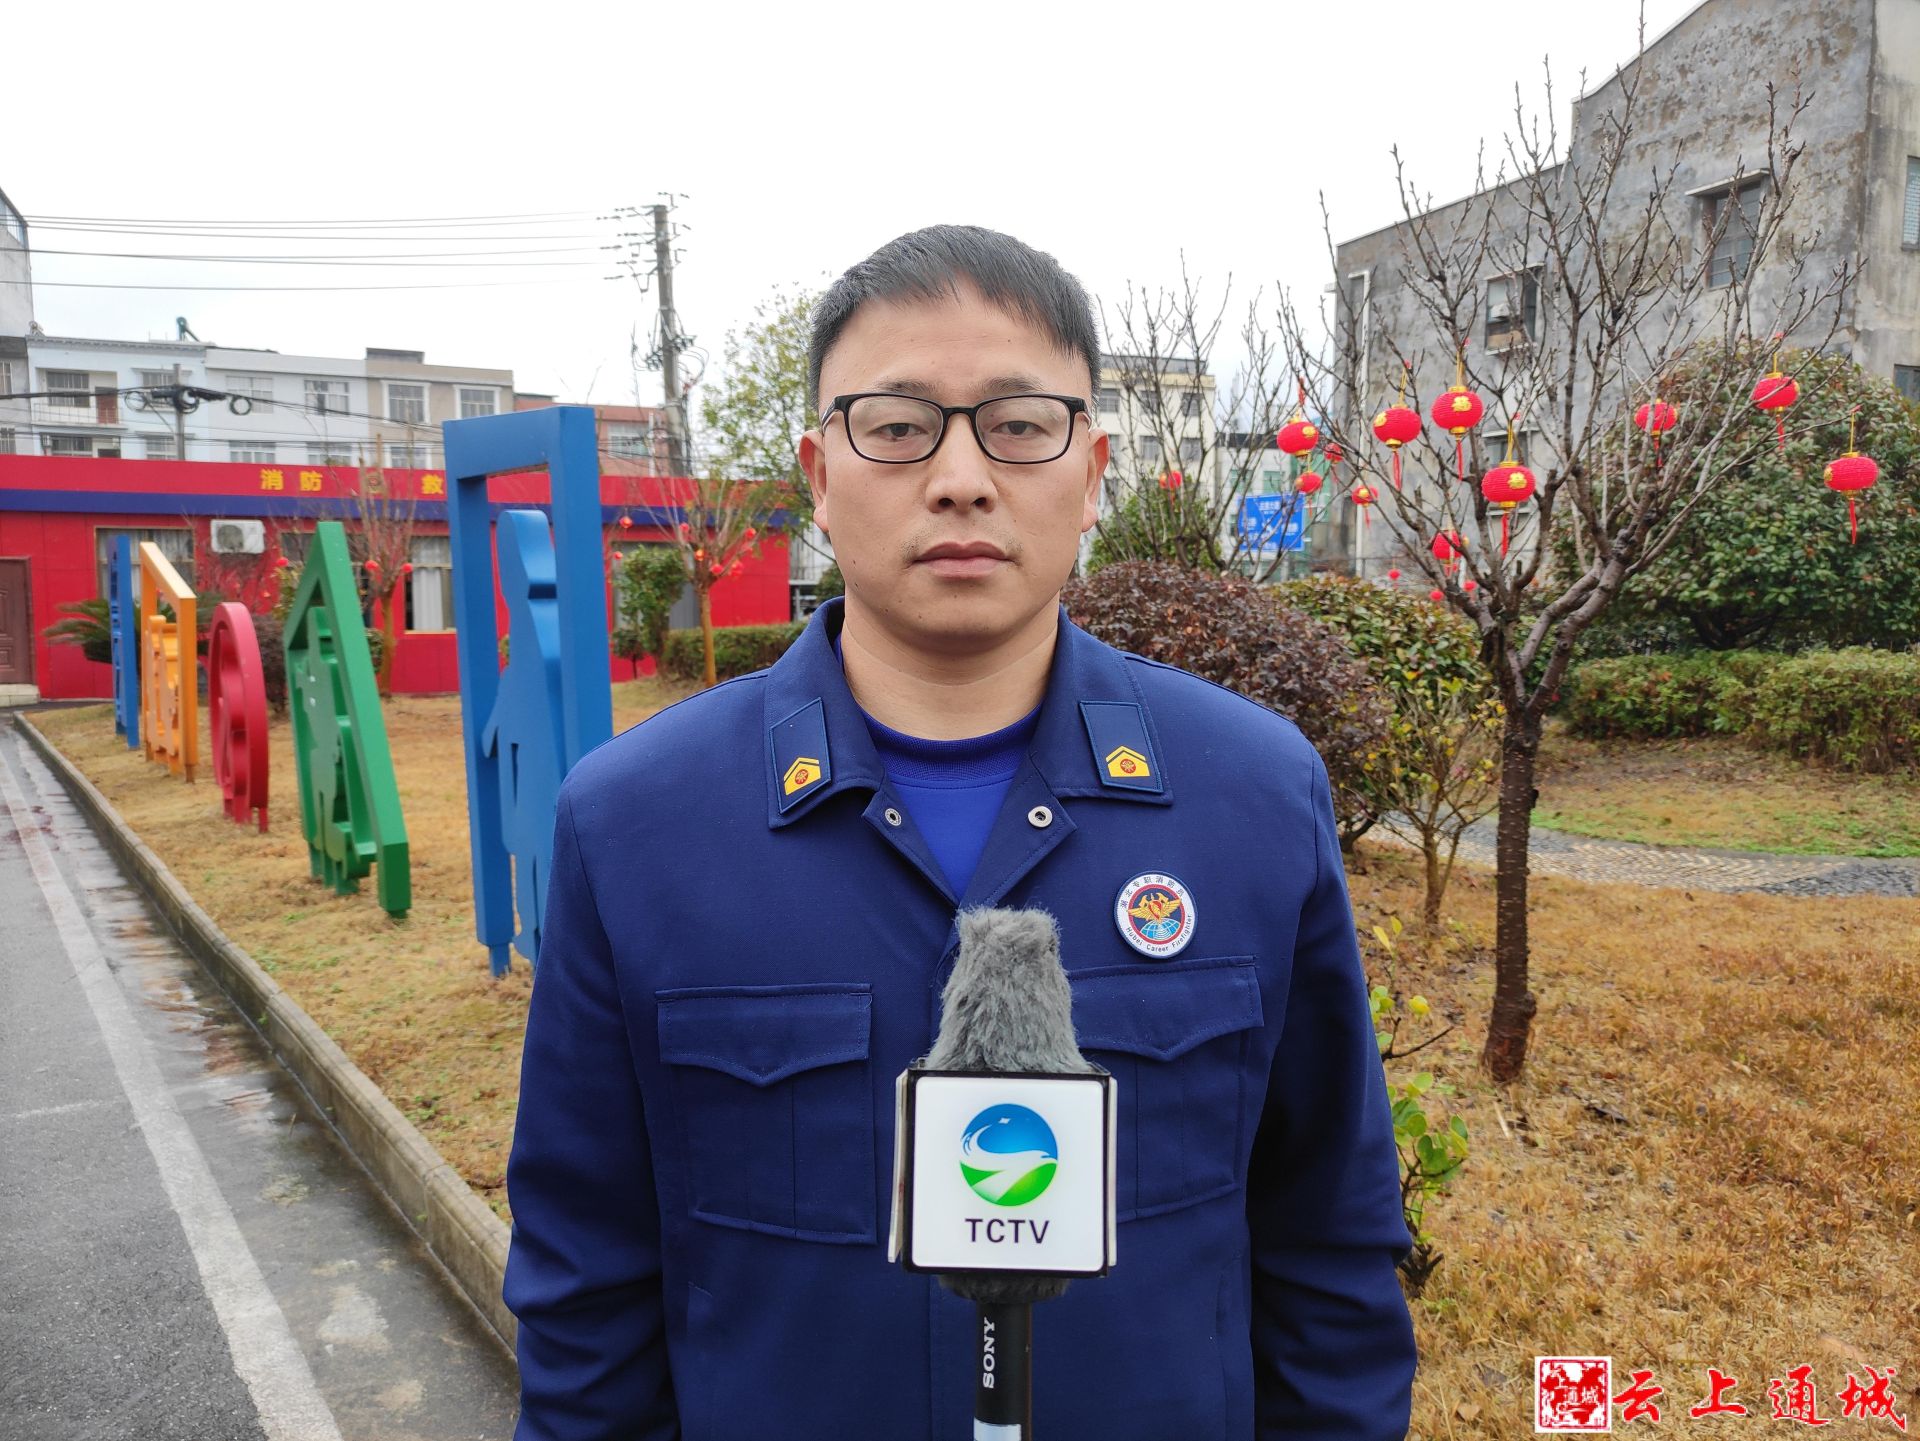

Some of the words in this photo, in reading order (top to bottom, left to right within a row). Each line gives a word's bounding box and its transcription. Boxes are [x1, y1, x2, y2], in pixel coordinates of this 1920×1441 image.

[260, 468, 322, 492] 消防
[421, 473, 444, 495] 救
[1126, 927, 1144, 946] Hubei
[1146, 944, 1169, 952] Career
[1171, 915, 1192, 948] Firefighter
[965, 1218, 1050, 1244] TCTV
[982, 1316, 996, 1389] SONY
